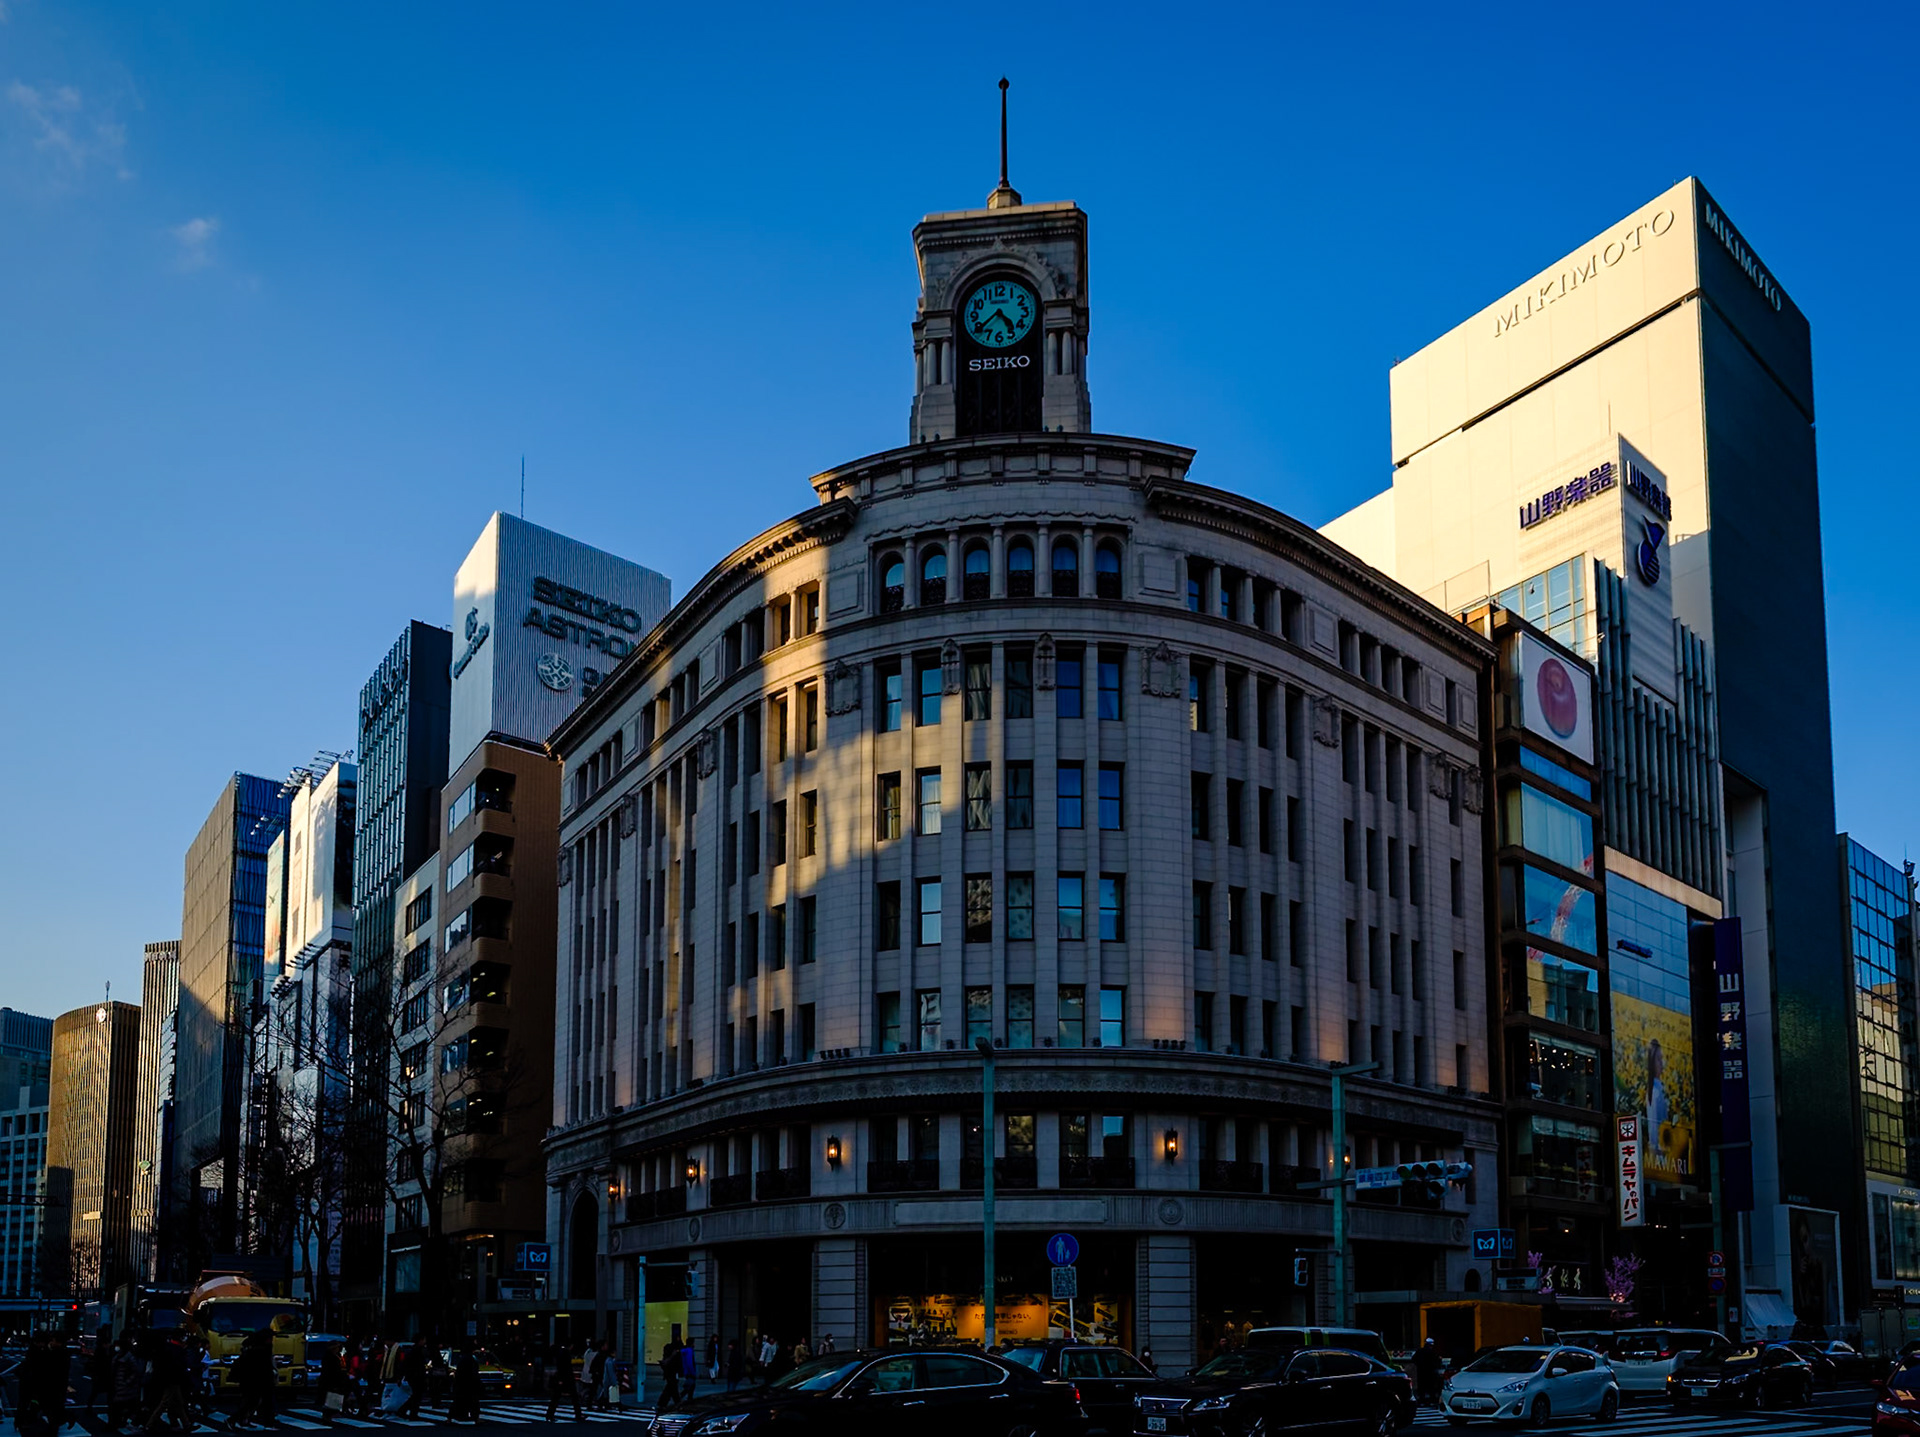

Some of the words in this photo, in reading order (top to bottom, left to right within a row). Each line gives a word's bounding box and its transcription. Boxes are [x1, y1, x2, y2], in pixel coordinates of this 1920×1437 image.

[1705, 203, 1782, 312] MIKIMOTO
[1495, 210, 1675, 338] MIKIMOTO
[995, 285, 1005, 297] 12
[1010, 288, 1013, 299] 1
[974, 299, 984, 310] 10
[1017, 295, 1025, 306] 2
[970, 311, 979, 322] 9
[1021, 307, 1029, 318] 3
[1016, 319, 1025, 329] 4
[985, 329, 993, 341] 7
[995, 331, 1004, 343] 6
[1007, 329, 1015, 339] 5
[968, 355, 1031, 371] SEIKO
[1520, 462, 1612, 529] 山野楽器
[533, 576, 641, 634] SEIKO
[523, 607, 637, 660] ASTRO
[1718, 972, 1743, 1080] 山野楽器
[1621, 1145, 1639, 1222] キムラヤのパン
